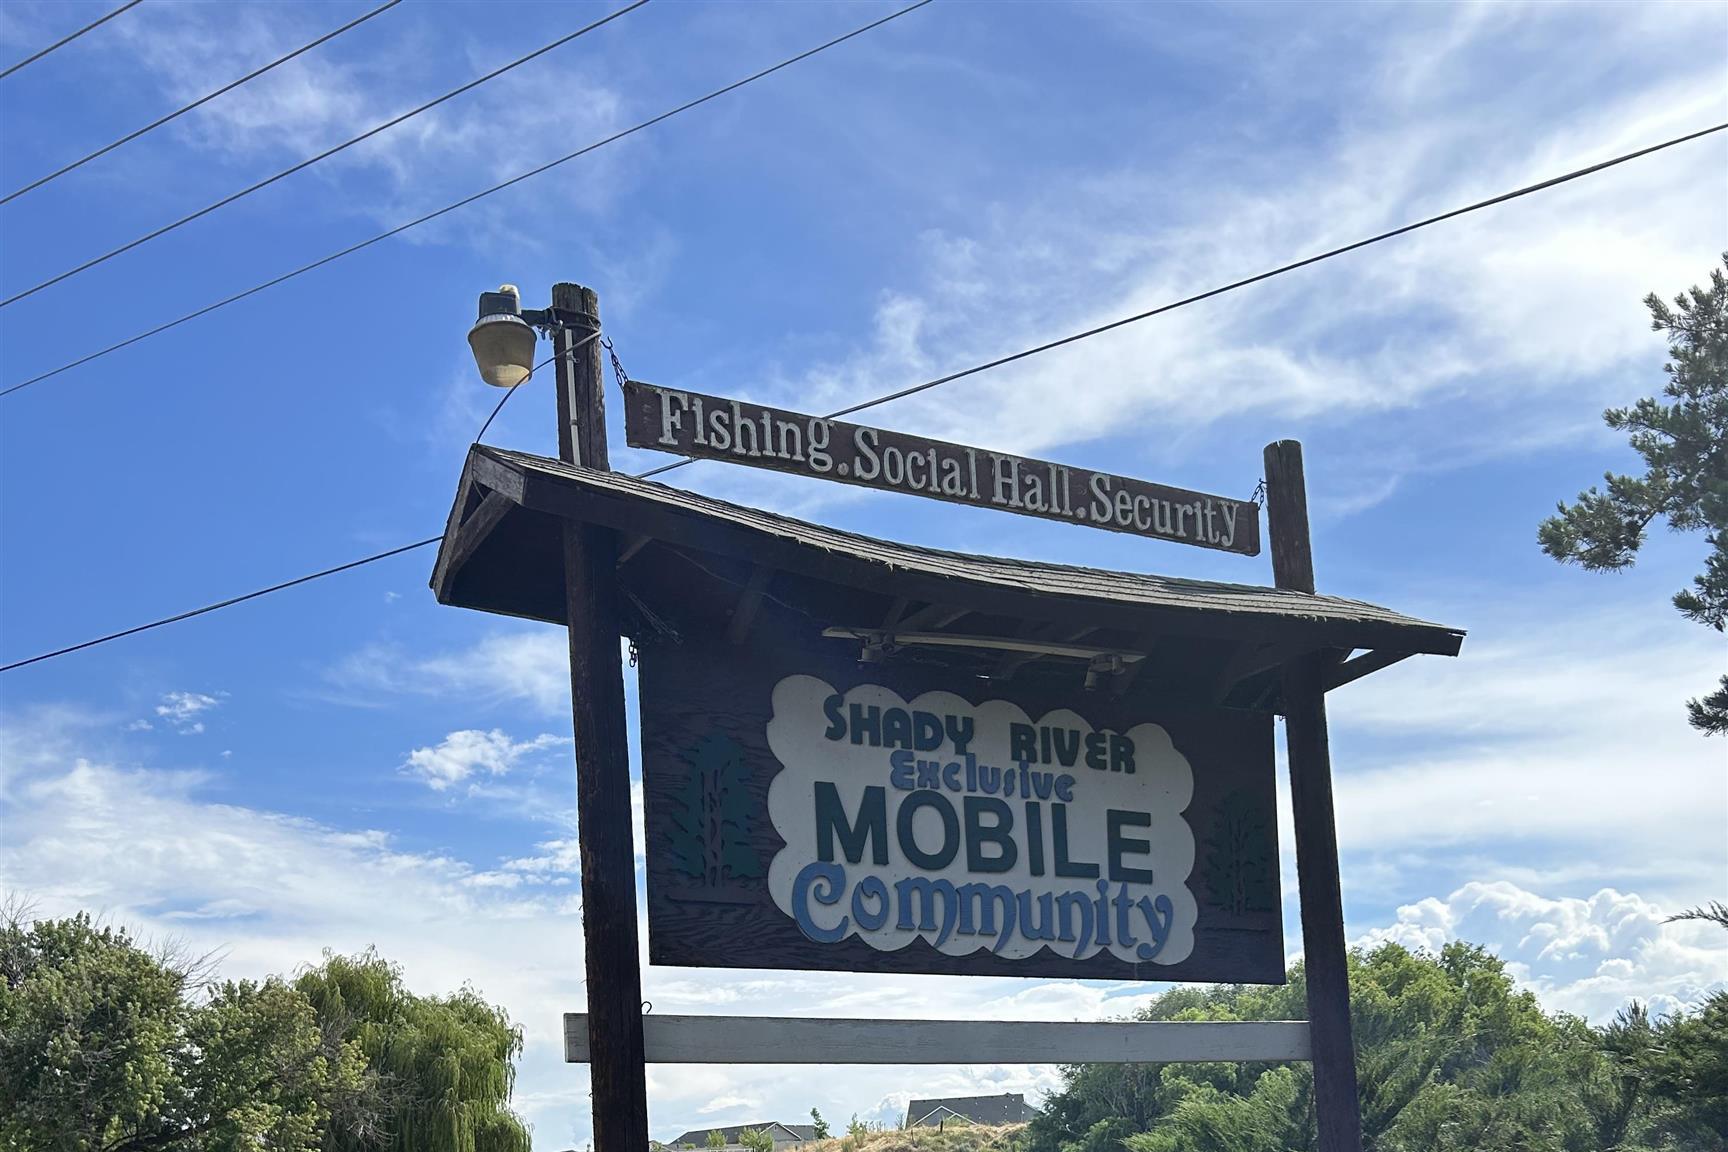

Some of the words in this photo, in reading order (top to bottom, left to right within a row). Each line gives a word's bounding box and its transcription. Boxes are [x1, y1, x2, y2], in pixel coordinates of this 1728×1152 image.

[853, 426, 981, 499] Social
[1089, 472, 1239, 547] Security
[823, 694, 974, 755] SHADY
[1010, 722, 1136, 774] RIVER
[889, 750, 1076, 802] Exclusive
[814, 781, 1154, 884] MOBILE
[791, 861, 1174, 960] Community
